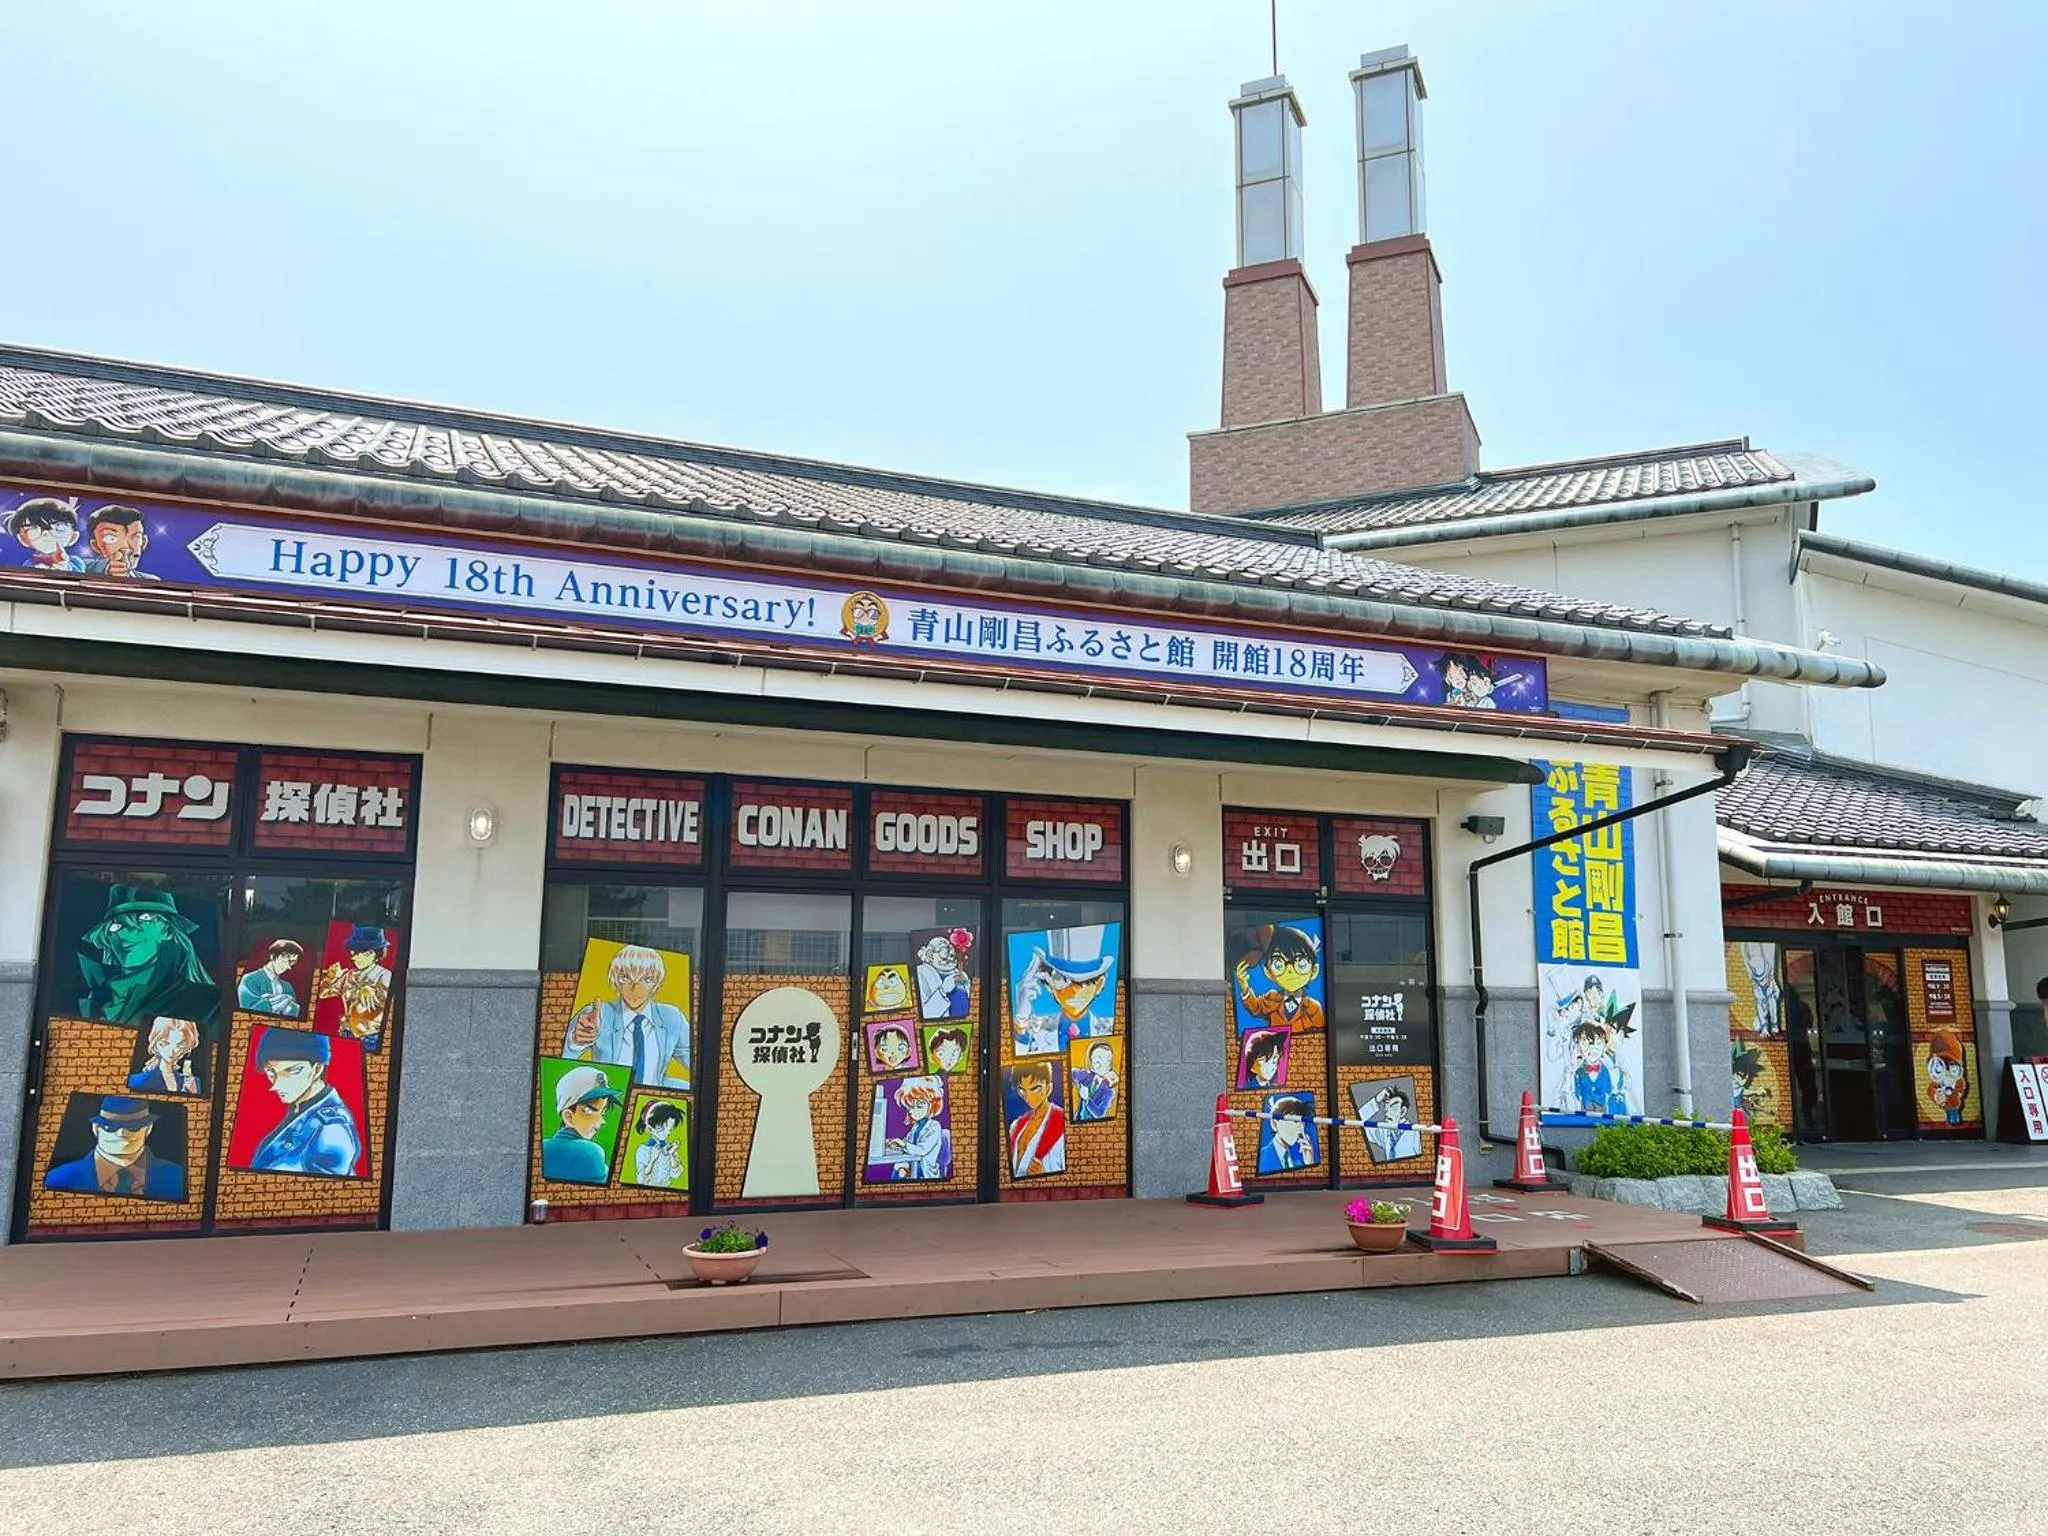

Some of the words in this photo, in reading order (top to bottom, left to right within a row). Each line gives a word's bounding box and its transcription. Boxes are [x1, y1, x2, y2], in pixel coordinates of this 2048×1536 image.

[269, 538, 422, 588] Happy
[444, 557, 535, 598] 18th
[555, 570, 815, 629] Anniversary!
[907, 608, 1196, 669] 青山剛昌ふるさと館
[1212, 639, 1365, 684] 開館18周年
[73, 772, 230, 821] コナン
[260, 780, 404, 828] 探偵社
[562, 794, 699, 843] DETECTIVE
[737, 804, 848, 850] CONAN
[875, 812, 979, 855] GOODS
[1026, 820, 1103, 861] SHOP
[1253, 826, 1289, 839] EXIT
[1241, 839, 1301, 873] 出口
[1819, 893, 1869, 905] ENTRANCE
[1807, 902, 1882, 927] 入館口
[1361, 995, 1392, 1008] コナン
[748, 1024, 802, 1043] コナン
[752, 1046, 806, 1063] 探偵社
[1737, 1154, 1766, 1213] 出口
